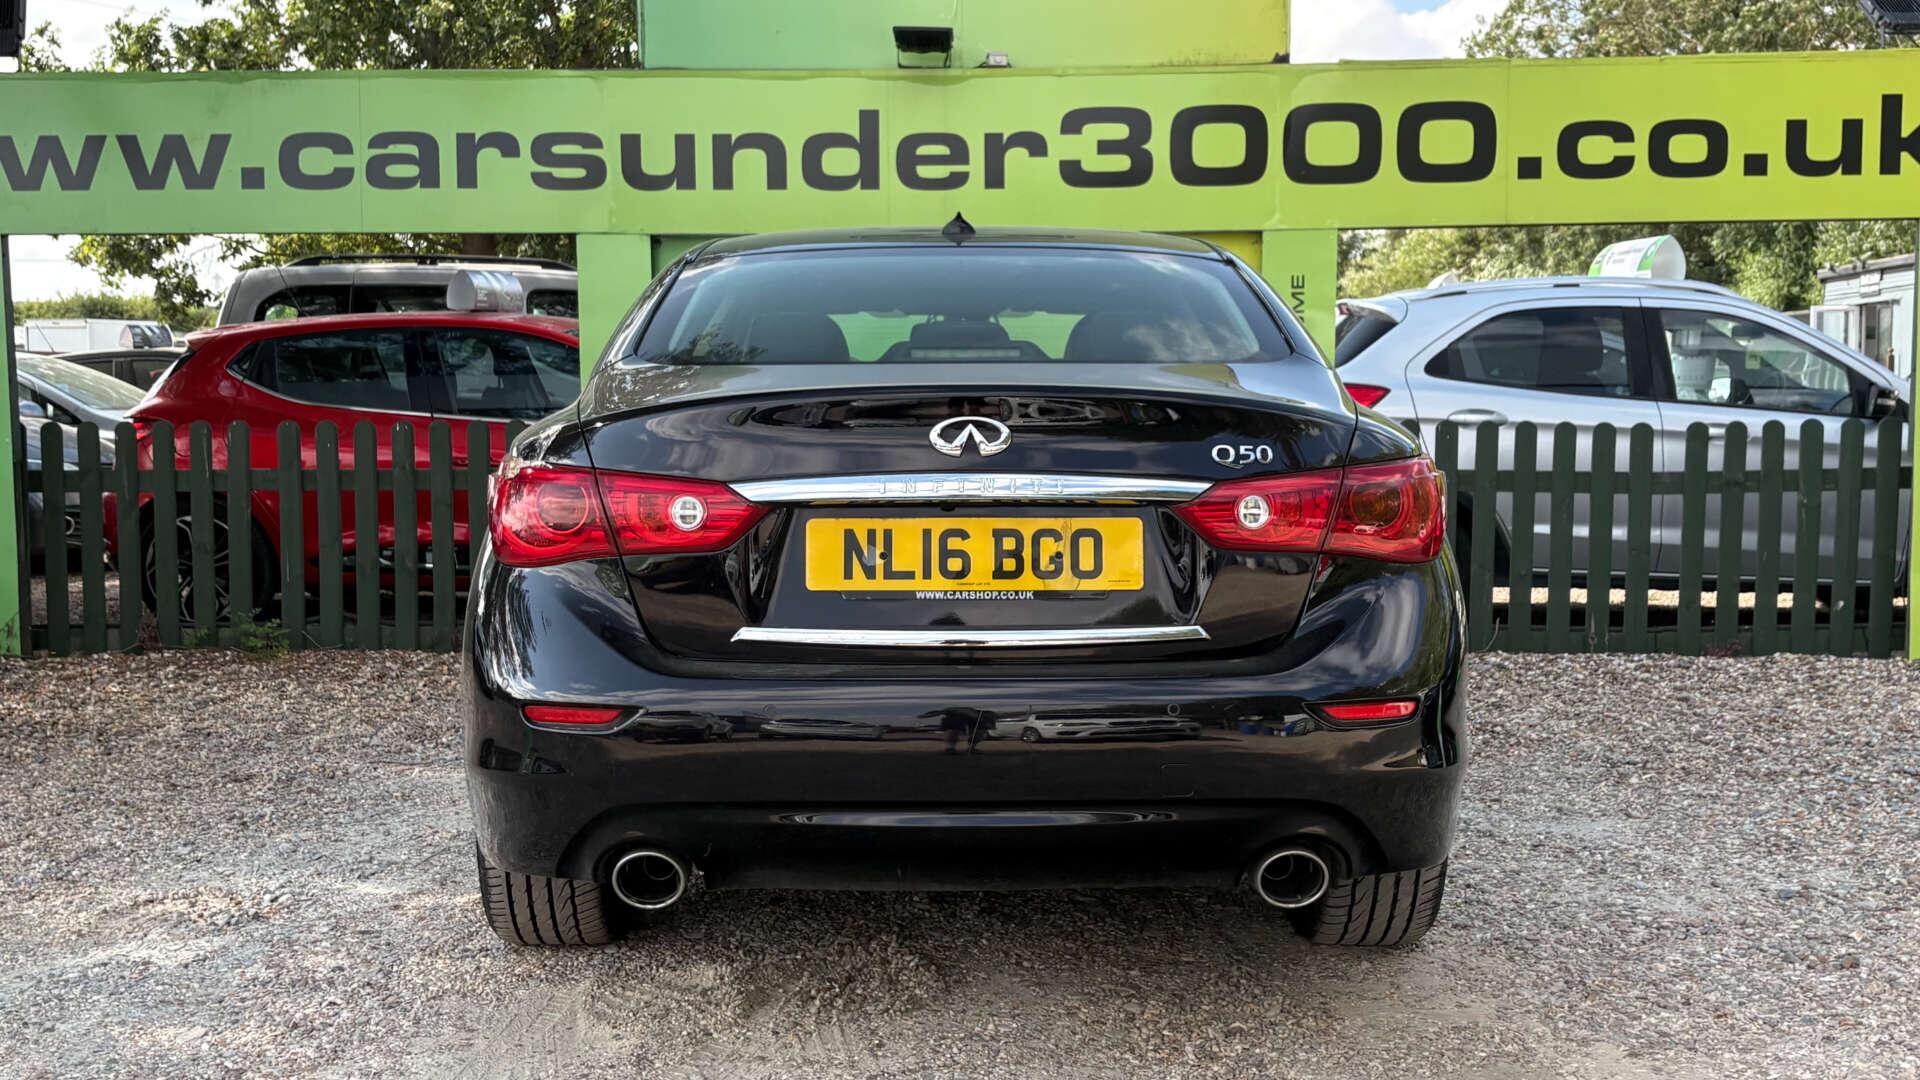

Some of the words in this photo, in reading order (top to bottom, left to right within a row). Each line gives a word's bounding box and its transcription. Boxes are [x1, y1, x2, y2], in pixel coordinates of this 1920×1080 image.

[1211, 444, 1273, 469] Q50
[879, 478, 1064, 494] INFINITI
[843, 528, 971, 581] NL16
[992, 528, 1103, 581] BGO
[916, 591, 1034, 600] WWW.CARSHOP.CO.UK
